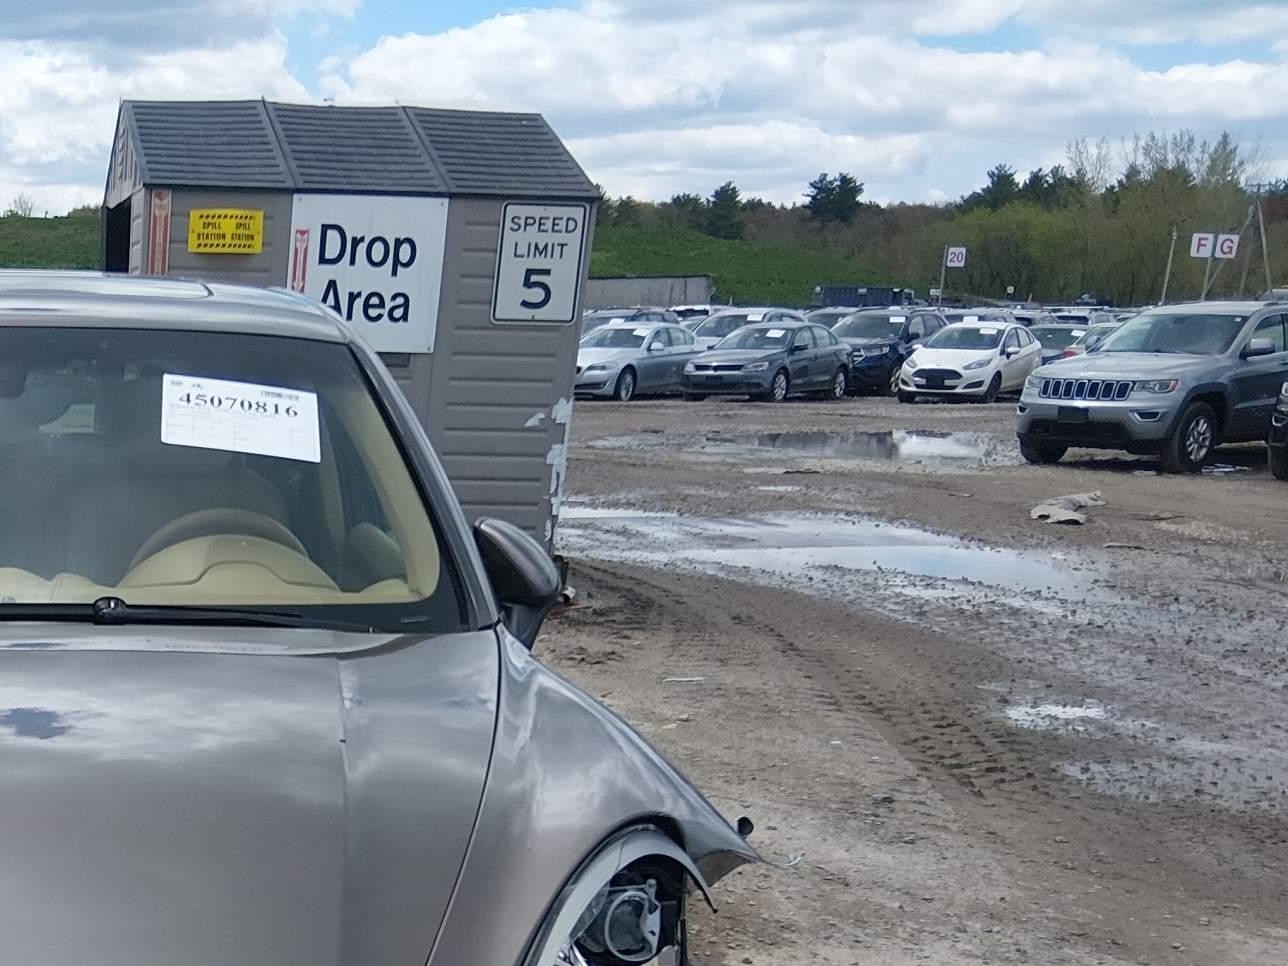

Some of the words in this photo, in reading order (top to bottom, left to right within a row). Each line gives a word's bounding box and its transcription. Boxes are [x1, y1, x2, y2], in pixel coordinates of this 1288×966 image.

[202, 221, 222, 230] SPILL
[235, 222, 252, 231] SPILL
[509, 216, 578, 233] SPEED
[197, 232, 227, 241] STATION
[318, 223, 418, 277] Drop
[513, 241, 569, 259] LIMIT
[1196, 237, 1209, 254] F
[1220, 238, 1235, 255] G
[949, 251, 964, 263] 20
[520, 268, 552, 310] 5
[321, 279, 411, 323] Area
[178, 392, 299, 418] 45070816
